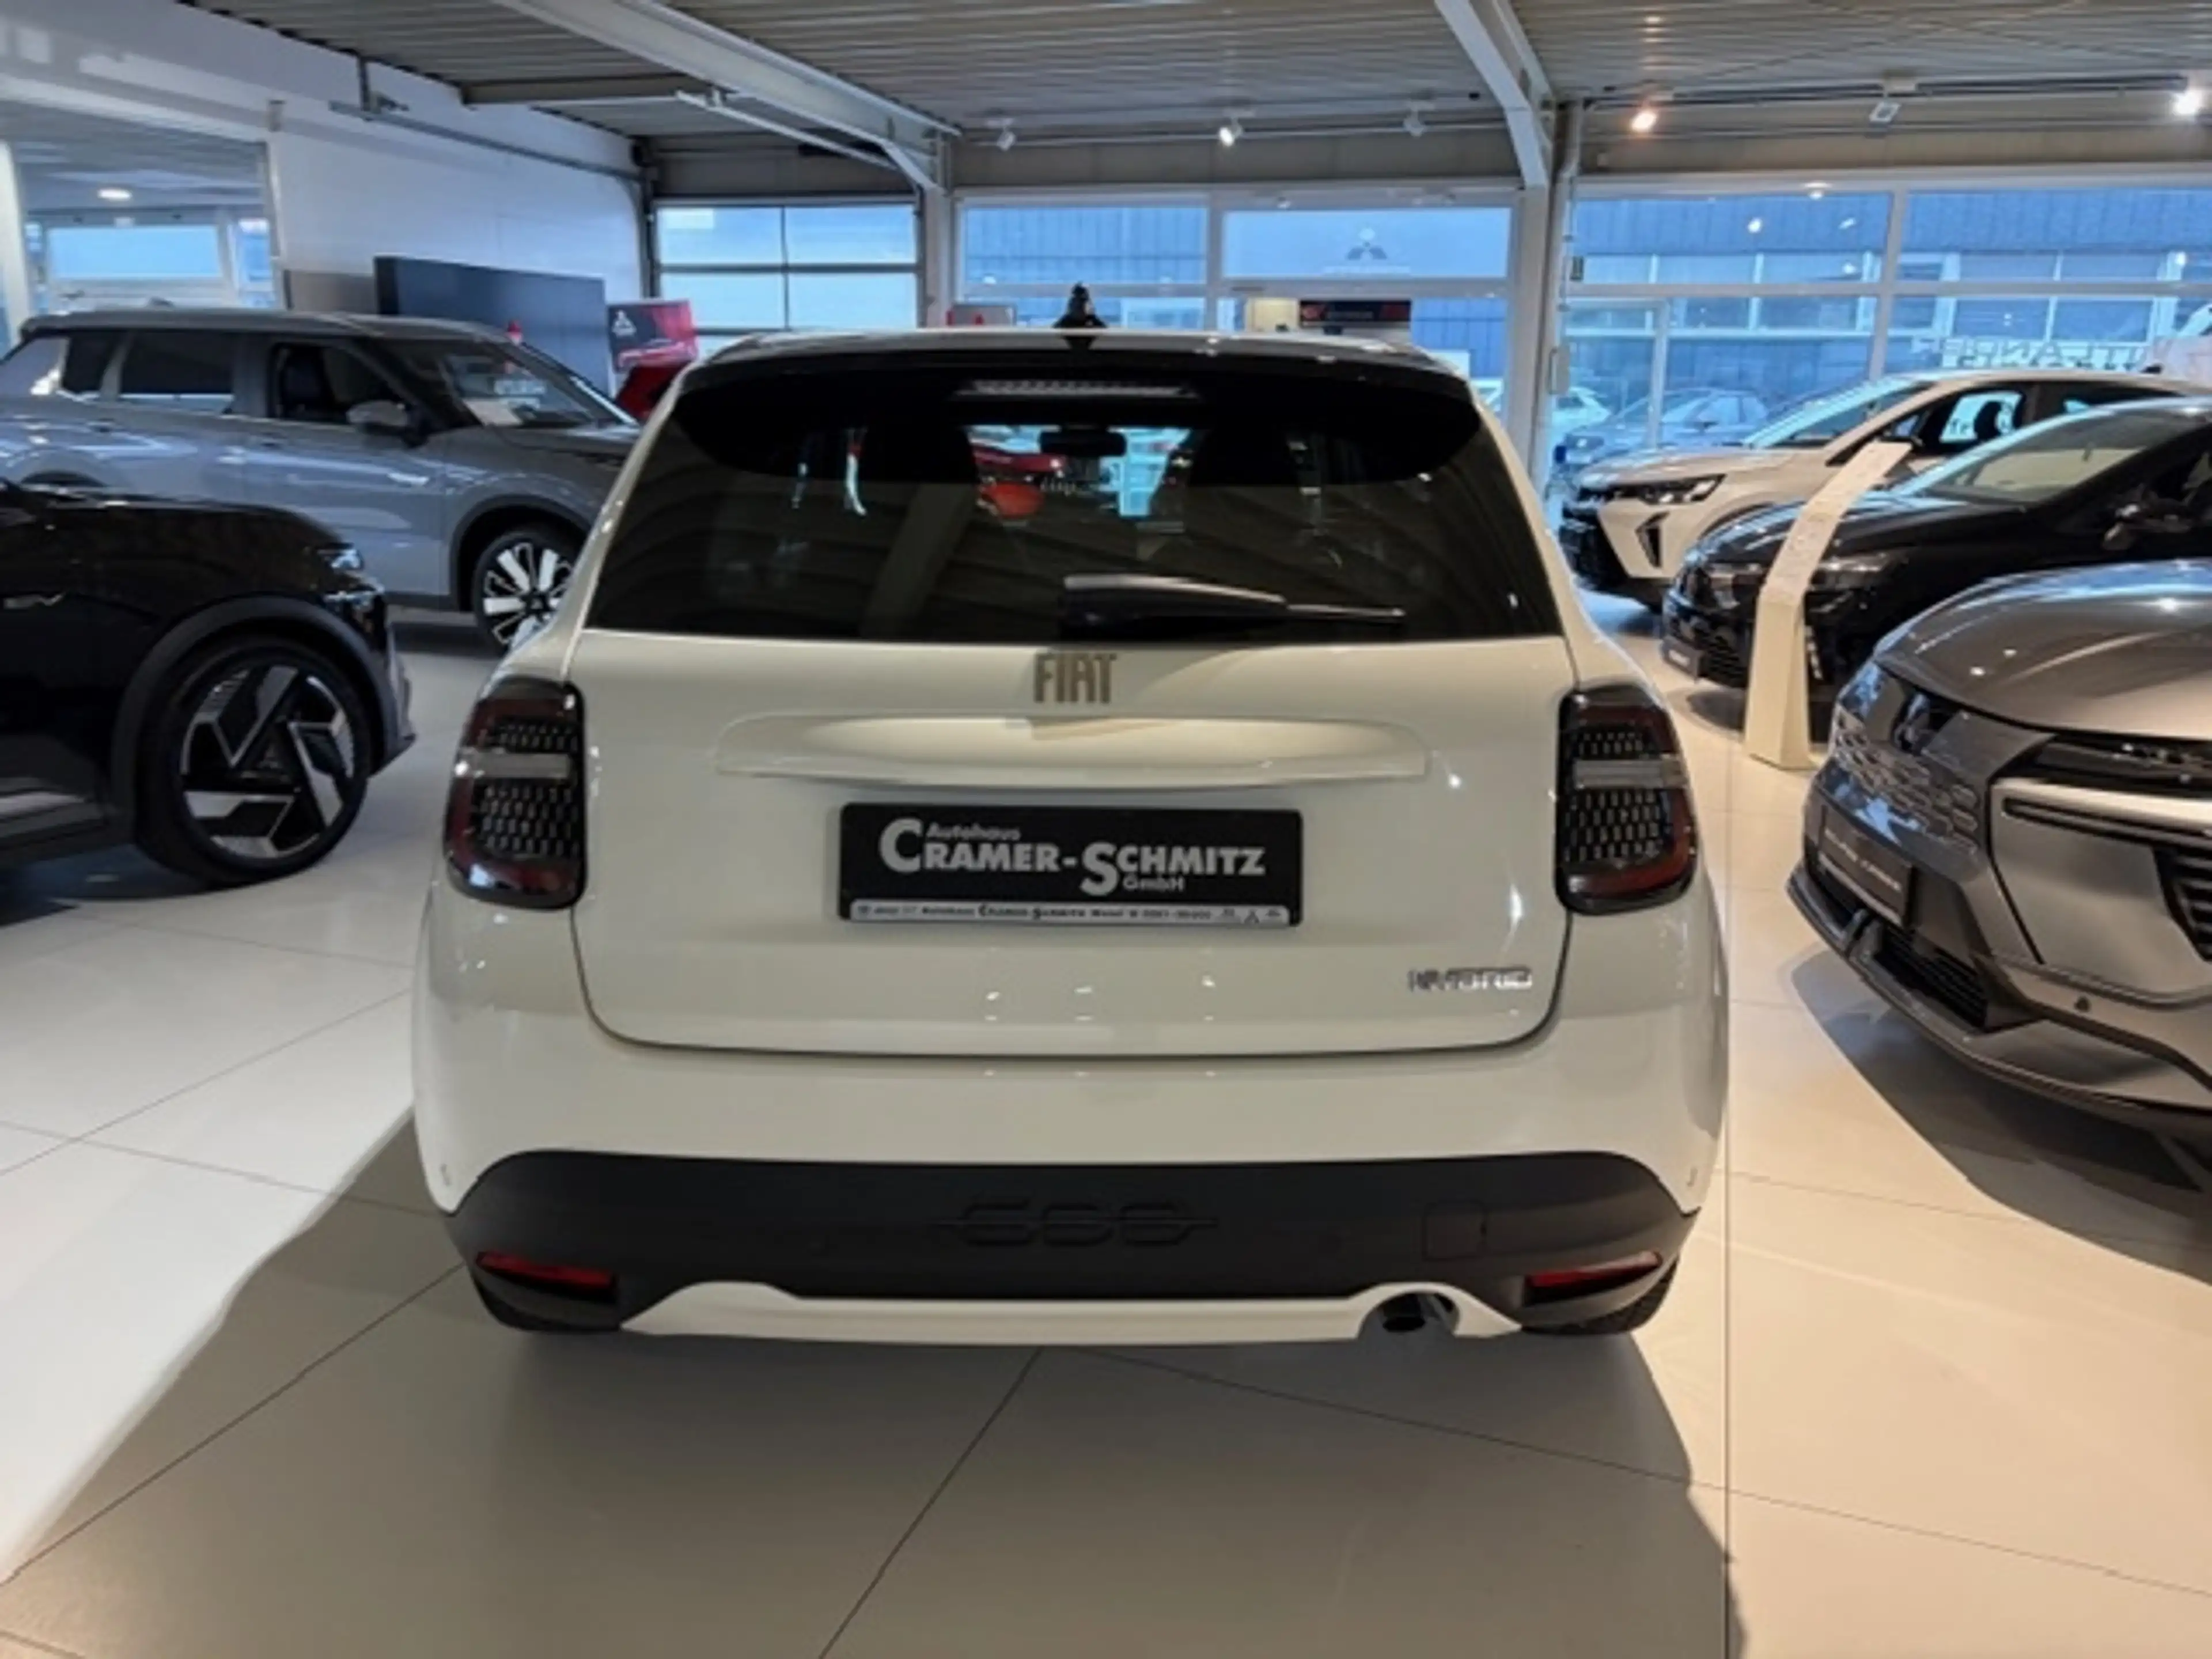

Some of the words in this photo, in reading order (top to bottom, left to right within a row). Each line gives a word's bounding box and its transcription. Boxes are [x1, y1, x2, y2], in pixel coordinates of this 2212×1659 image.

[1033, 653, 1118, 704] FIAT
[925, 822, 1021, 841] Autohaus
[879, 817, 1266, 896] CRAMER-SCHMITZ
[1123, 875, 1184, 891] GmbH
